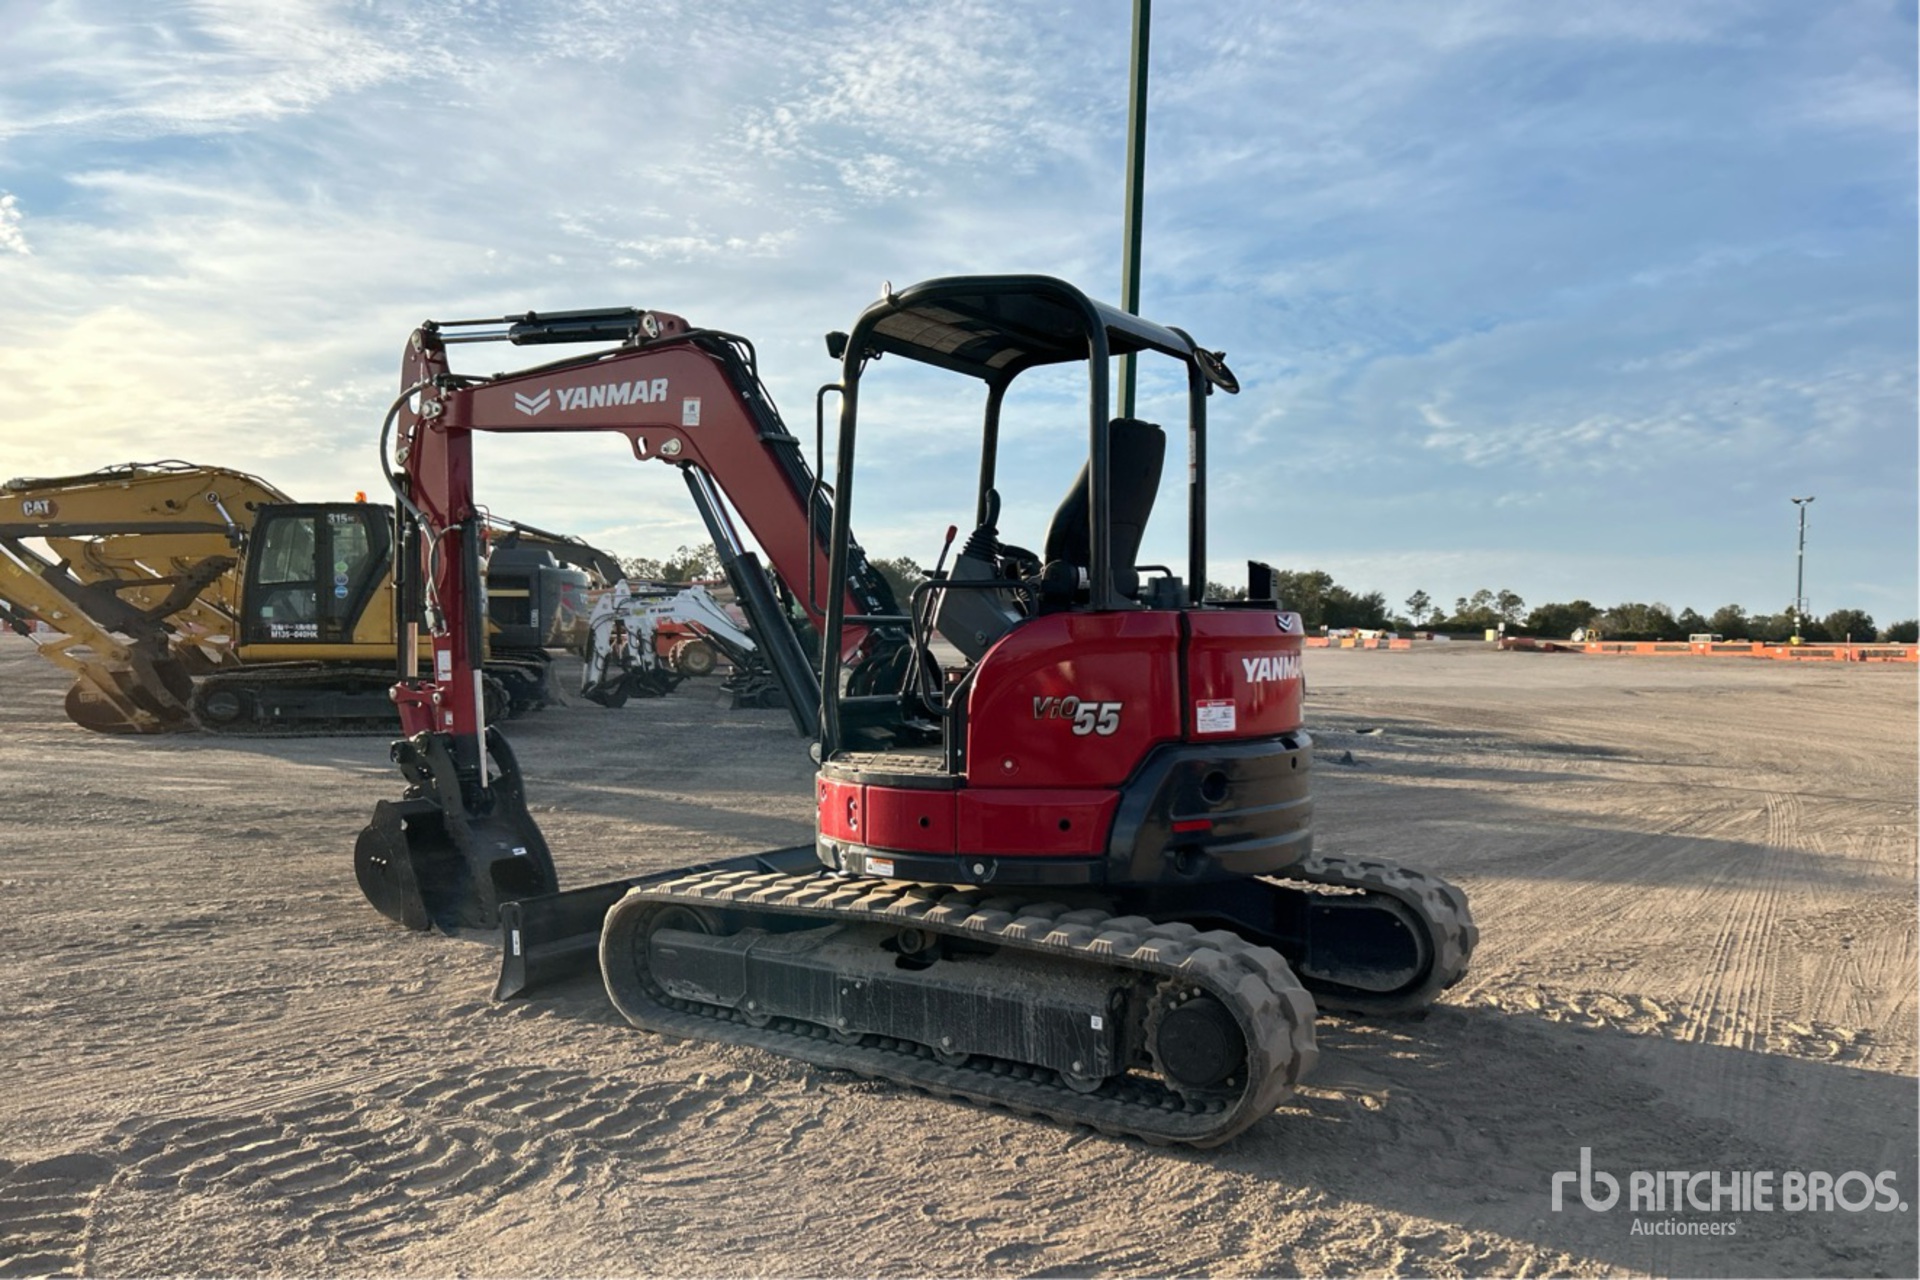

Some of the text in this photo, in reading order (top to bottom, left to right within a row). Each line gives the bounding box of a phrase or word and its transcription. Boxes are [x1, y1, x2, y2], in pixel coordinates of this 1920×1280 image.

[556, 378, 668, 411] YANMAR
[23, 500, 50, 517] CAT
[1242, 656, 1301, 682] YANMA
